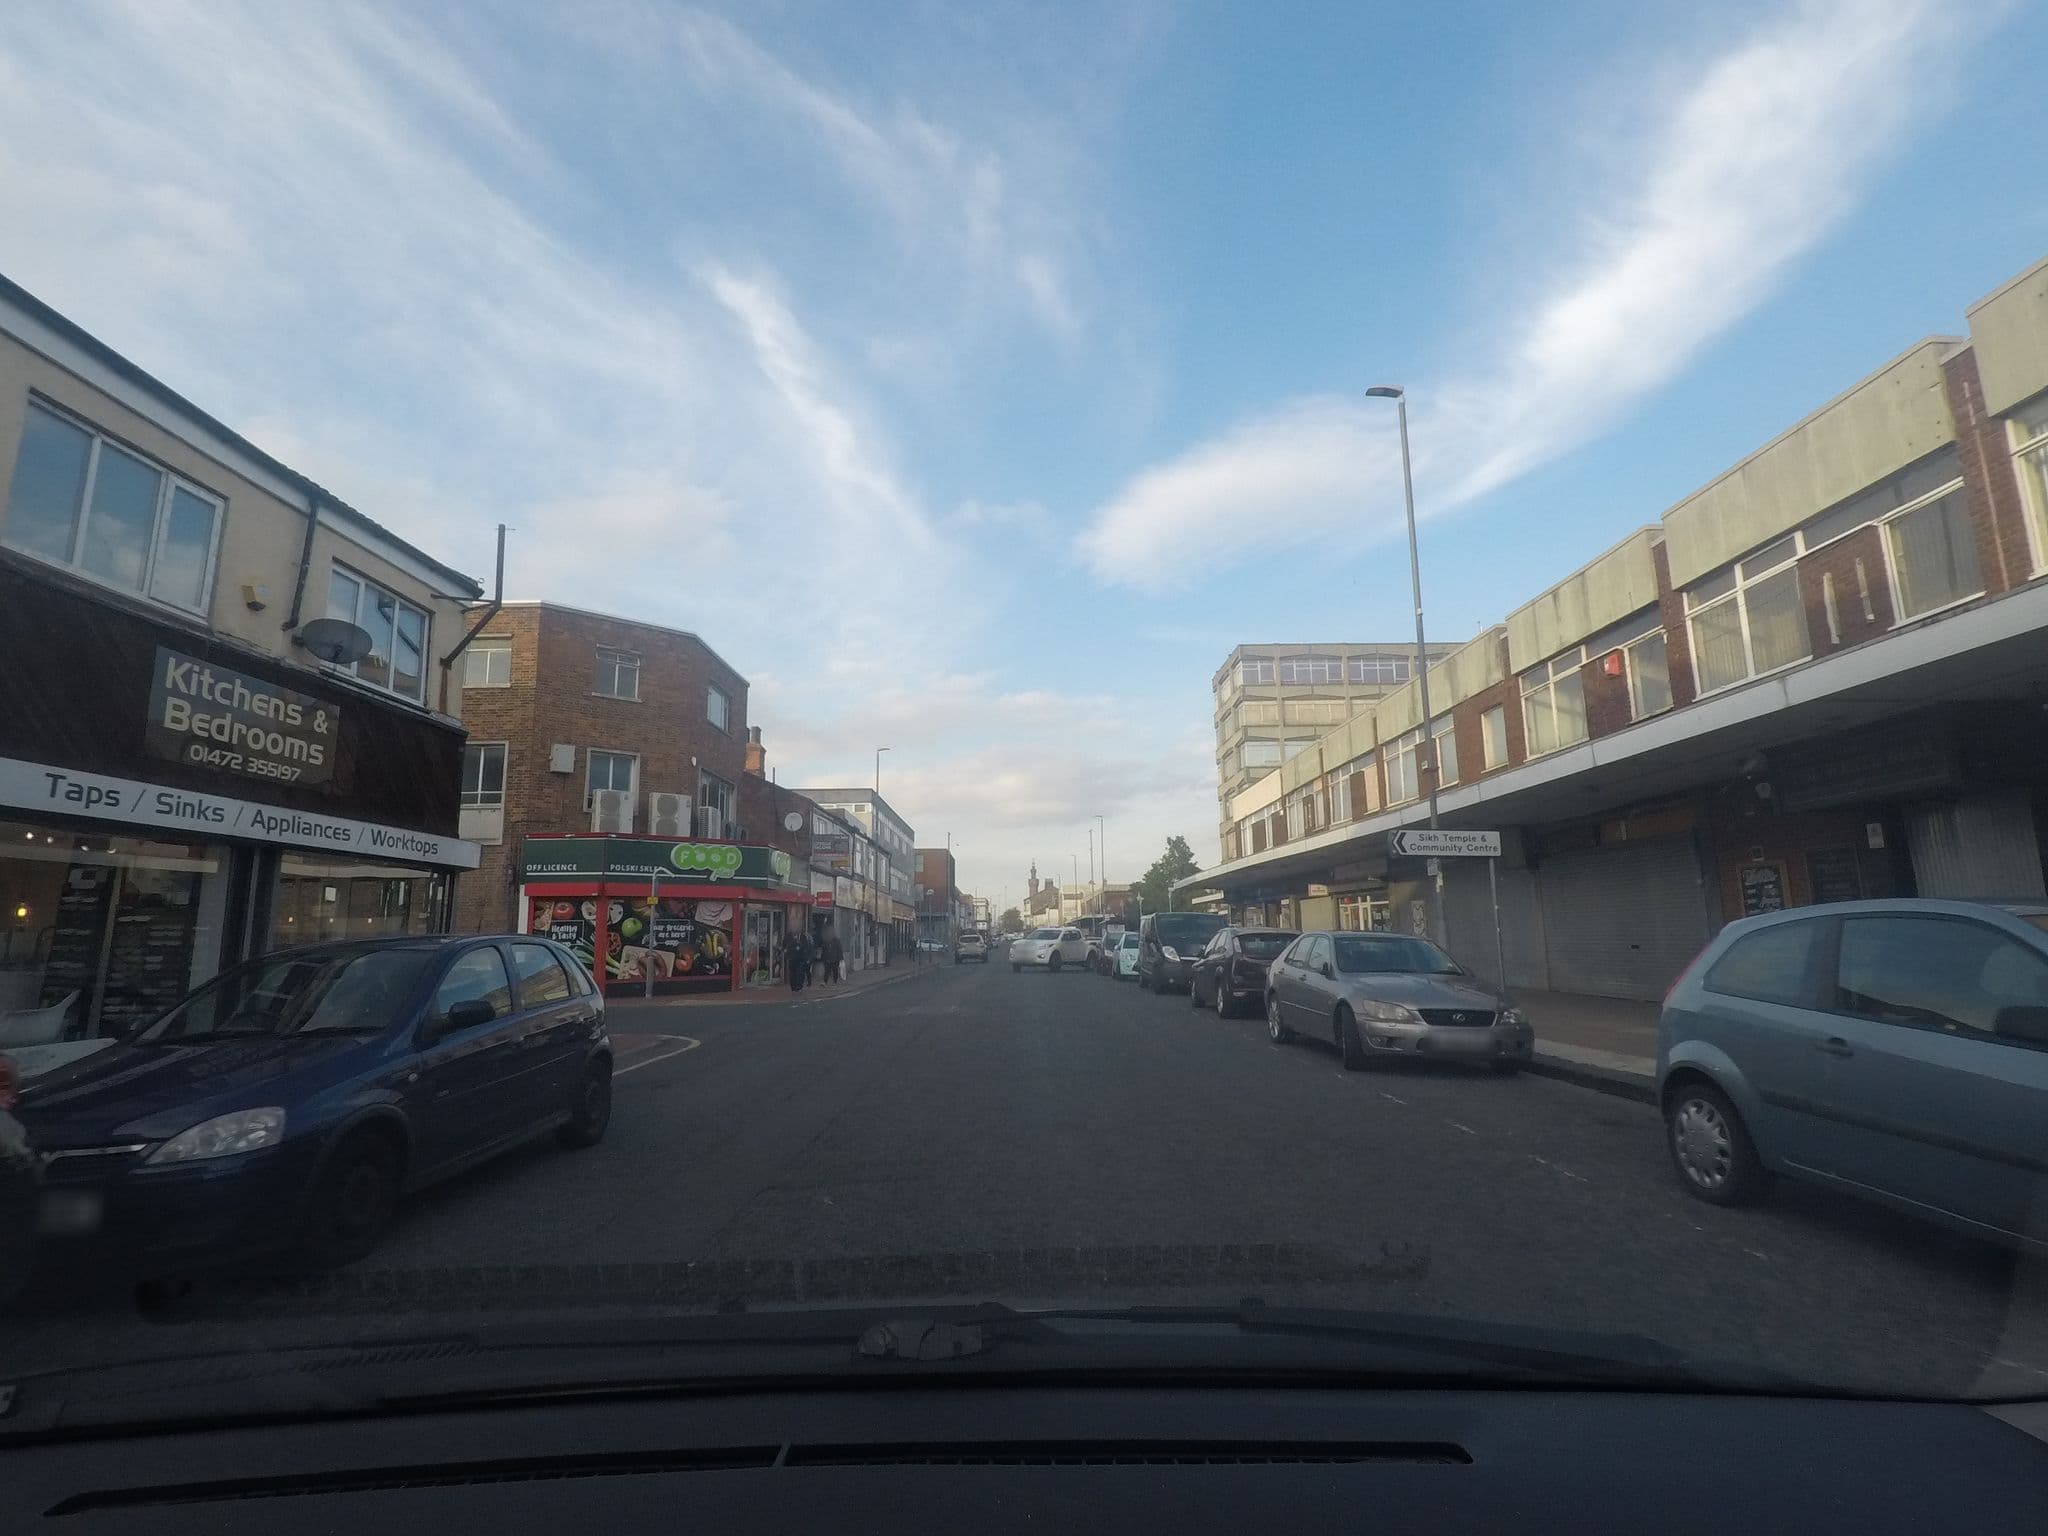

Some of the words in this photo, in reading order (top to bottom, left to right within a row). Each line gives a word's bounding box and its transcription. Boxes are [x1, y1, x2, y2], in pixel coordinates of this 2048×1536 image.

[165, 657, 303, 726] Kitchens
[313, 710, 328, 735] &
[163, 696, 324, 765] Bedrooms
[189, 744, 244, 770] 01472
[247, 757, 301, 782] 355197
[45, 772, 121, 809] Taps
[155, 792, 225, 823] Sinks
[250, 809, 351, 842] Appliances
[371, 828, 438, 856] Worktops
[1409, 843, 1463, 853] Community
[1466, 844, 1499, 852] Centre
[1418, 833, 1439, 842] Sikh
[1443, 834, 1477, 843] Temple
[543, 863, 577, 871] LICENCE
[610, 864, 638, 872] POLSKI
